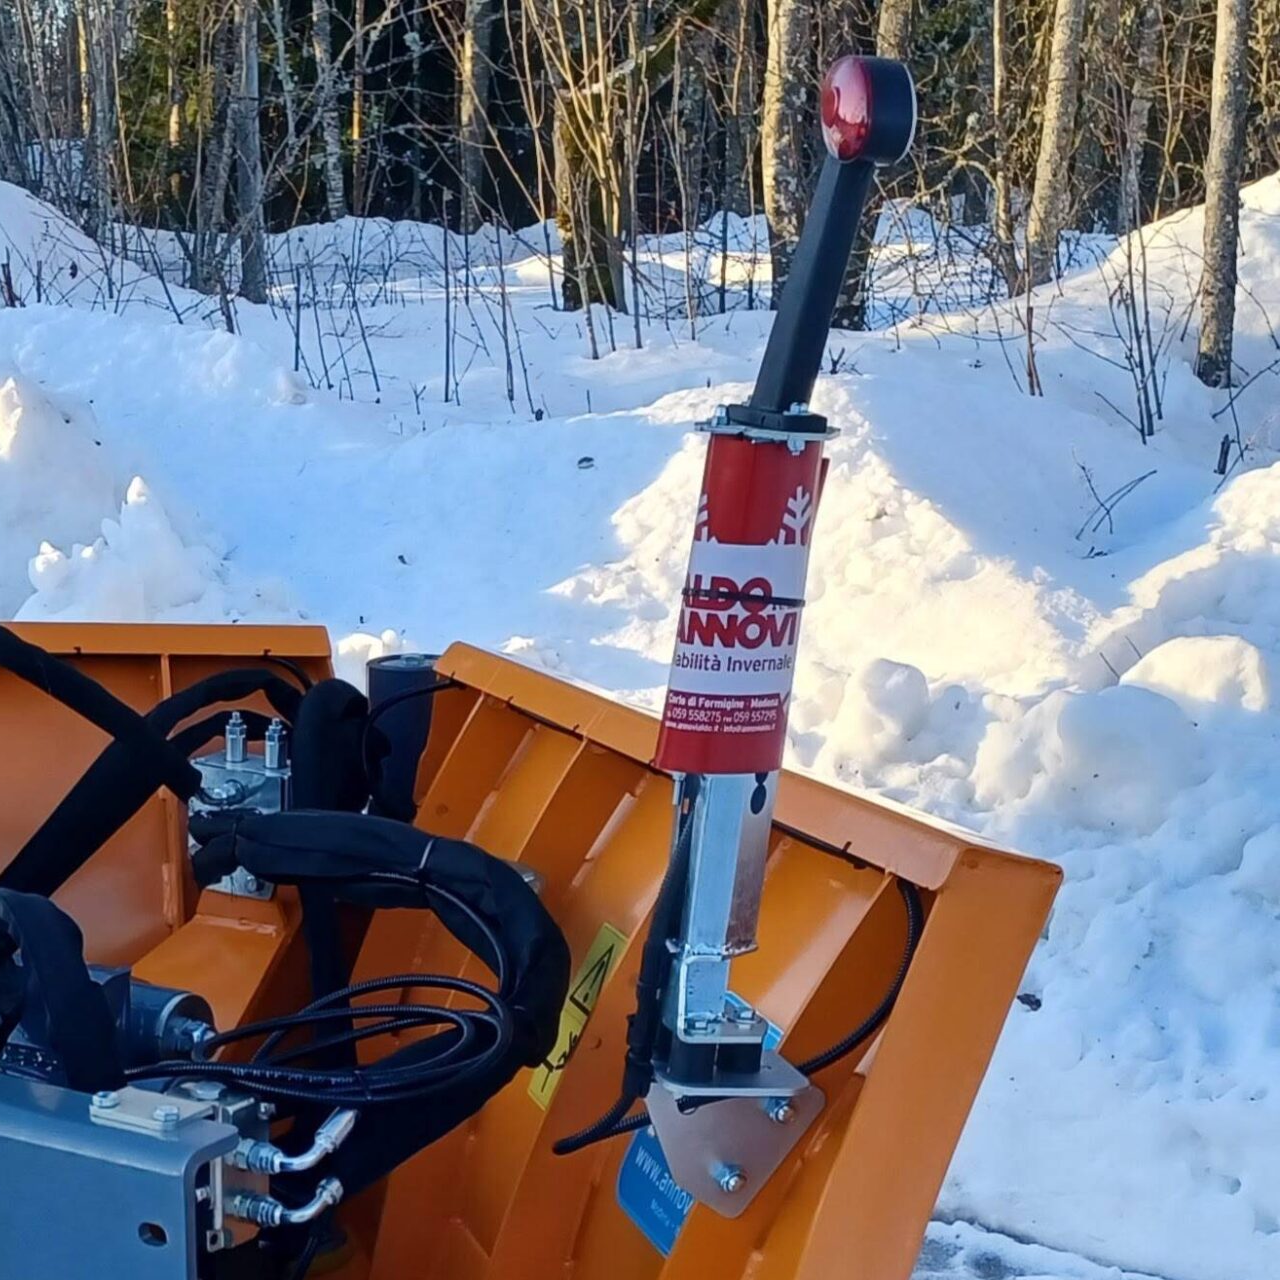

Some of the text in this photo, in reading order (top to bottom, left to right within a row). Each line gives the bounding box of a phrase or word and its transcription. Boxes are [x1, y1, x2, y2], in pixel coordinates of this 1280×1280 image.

[727, 654, 792, 672] Invernale
[688, 696, 697, 706] di
[699, 698, 744, 711] Formigine
[672, 707, 687, 719] 059
[688, 709, 721, 723] 558275
[733, 711, 750, 723] 059
